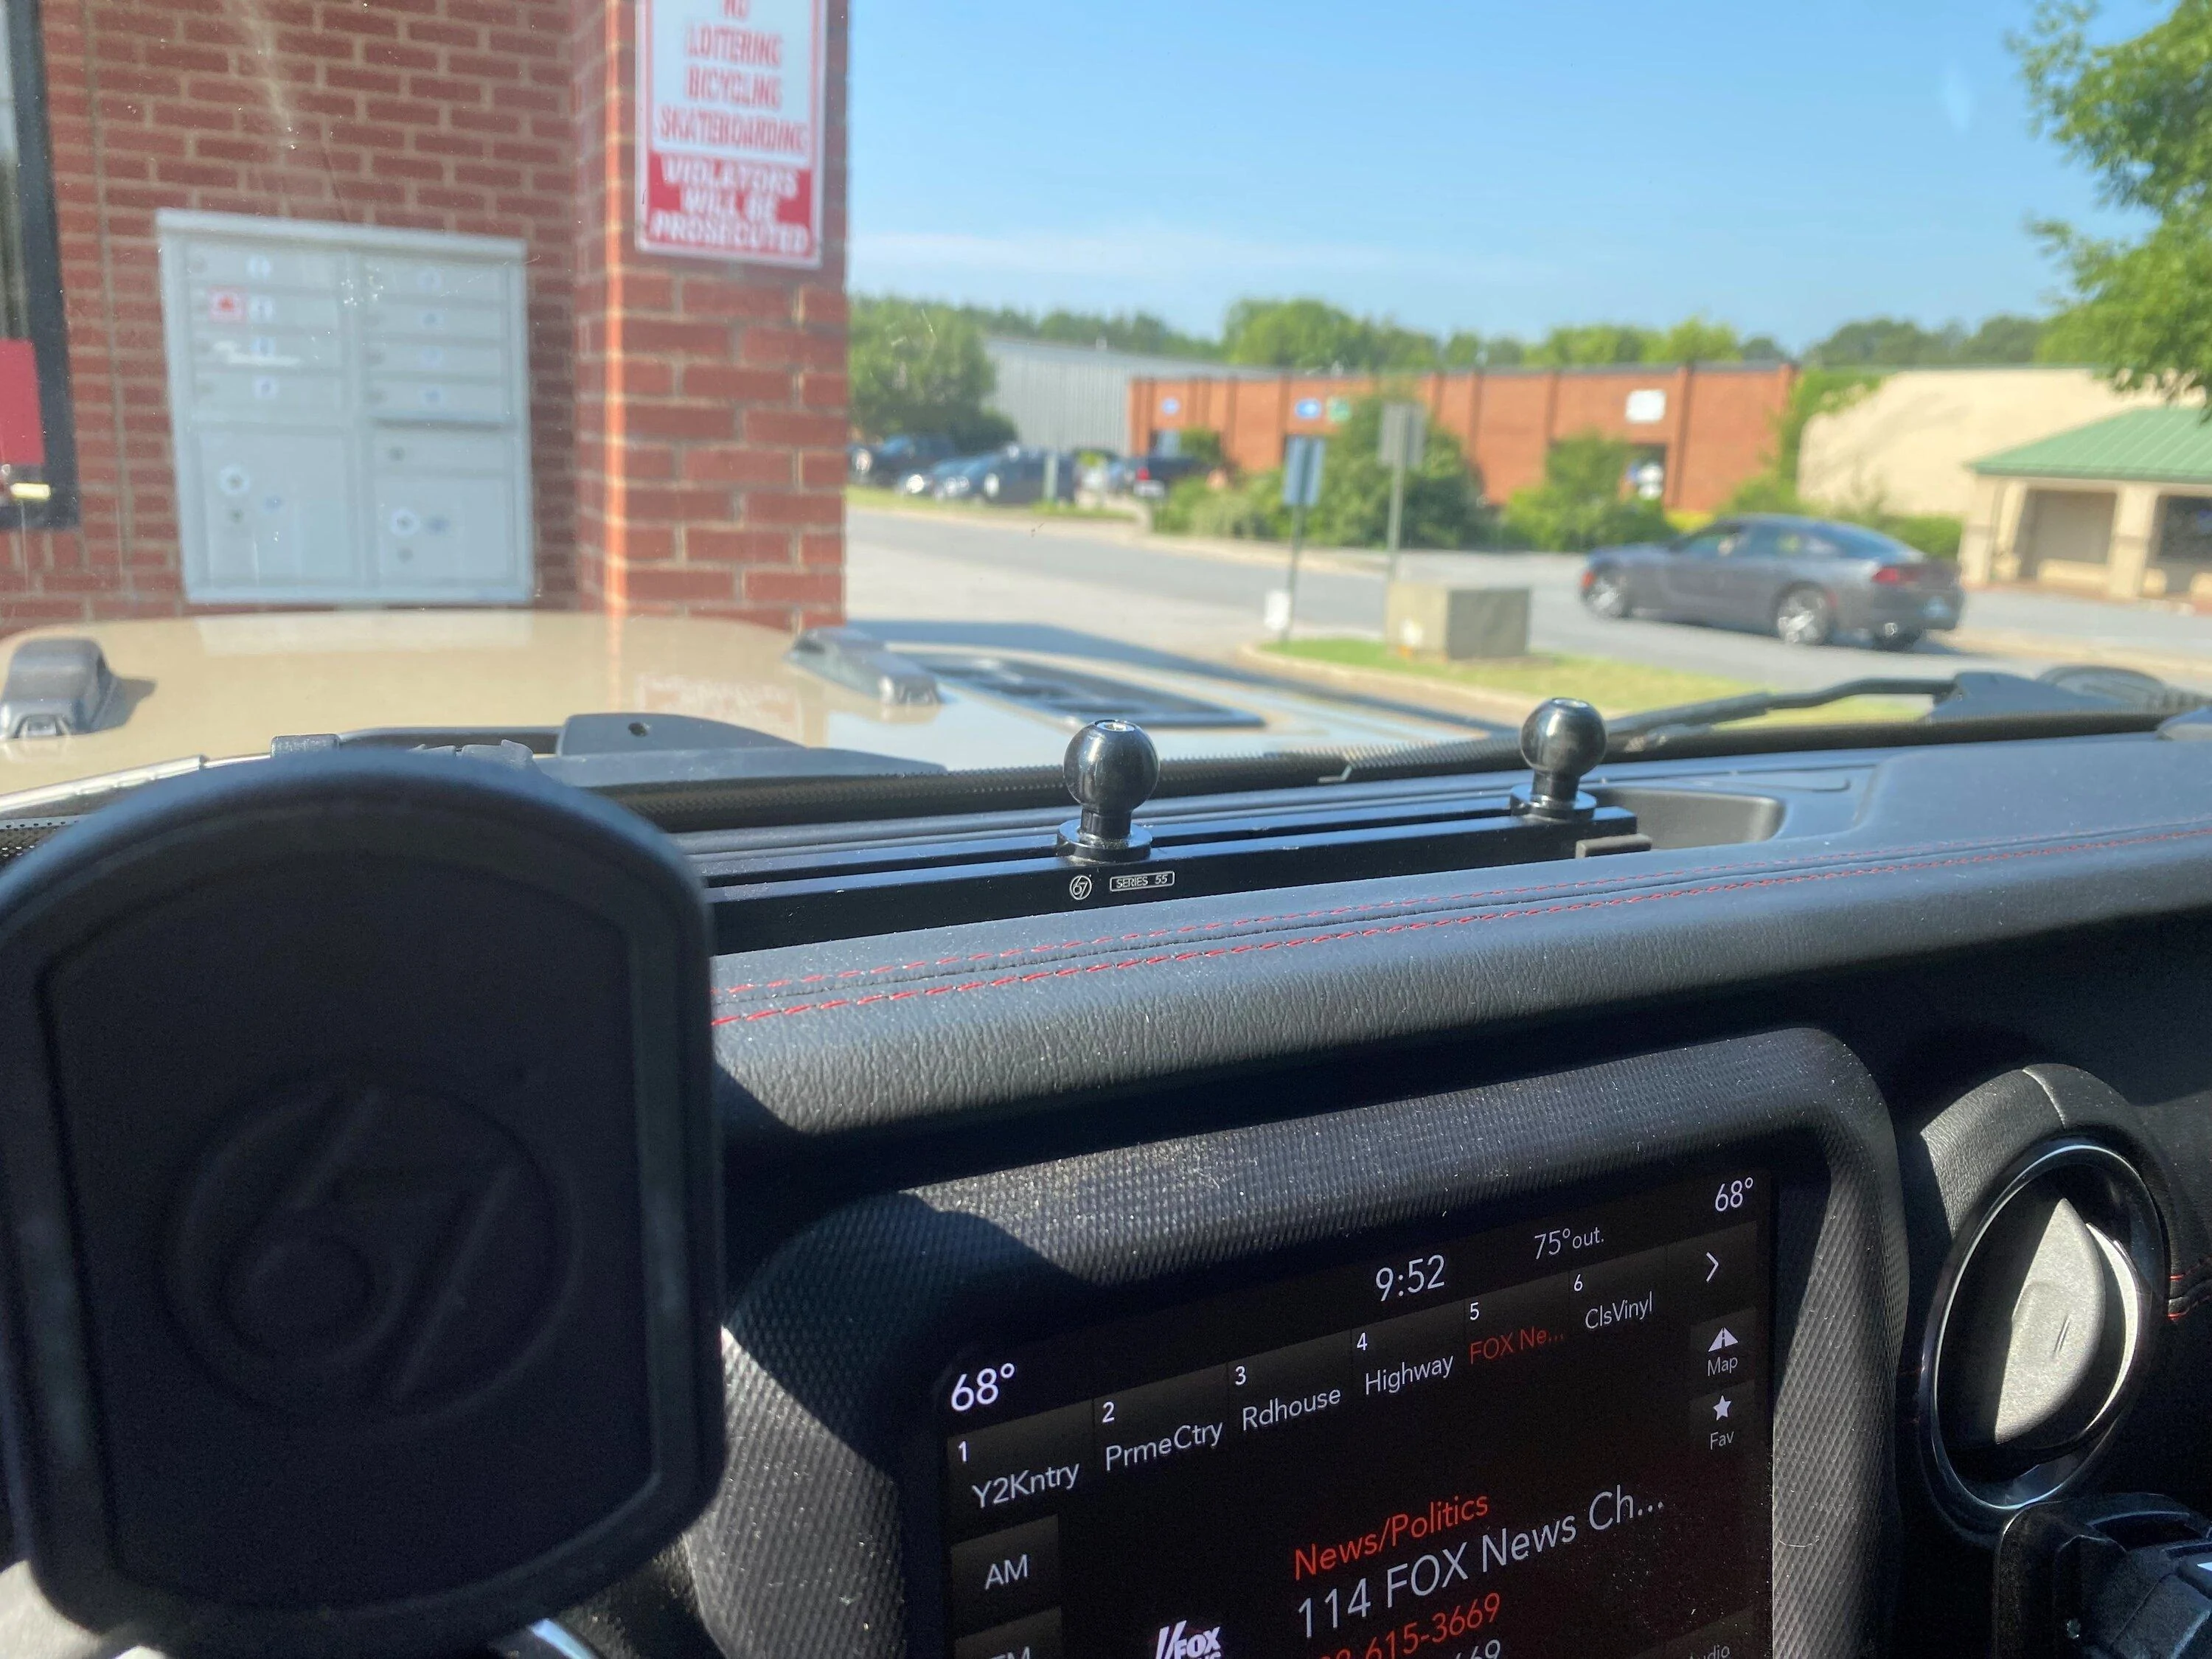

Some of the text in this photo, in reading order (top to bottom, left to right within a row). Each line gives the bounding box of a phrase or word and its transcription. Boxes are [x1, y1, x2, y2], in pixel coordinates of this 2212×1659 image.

[689, 65, 780, 110] BICYCLING
[661, 105, 807, 153] SKATEBOARDING
[663, 153, 798, 198] VIOLATORS
[682, 186, 779, 224] WILL BE
[651, 211, 808, 252] PROSECUTED
[1115, 874, 1168, 888] SERIES 55
[1714, 1177, 1754, 1212] 68°
[1375, 1254, 1446, 1301] 9:52
[1573, 1273, 1583, 1292] 6
[1470, 1302, 1480, 1321] 5
[1585, 1290, 1653, 1329] ClsVinyl
[1357, 1332, 1368, 1351] 4
[1470, 1326, 1564, 1365] FOX Ne...
[1235, 1366, 1246, 1385] 3
[1364, 1353, 1454, 1396] Highway
[1707, 1356, 1738, 1377] Map
[950, 1363, 1015, 1411] 68°
[1102, 1402, 1115, 1423] 2
[1242, 1387, 1341, 1431] Rdhouse
[959, 1441, 967, 1462] 1
[1105, 1419, 1224, 1471] PrmeCtry
[1709, 1430, 1734, 1450] Fav
[972, 1463, 1079, 1509] Y2Kntry
[1295, 1495, 1489, 1582] News/Politics
[985, 1554, 1029, 1590] AM
[1298, 1484, 1665, 1639] 114 FOX News Ch...
[1173, 1626, 1221, 1659] FOX
